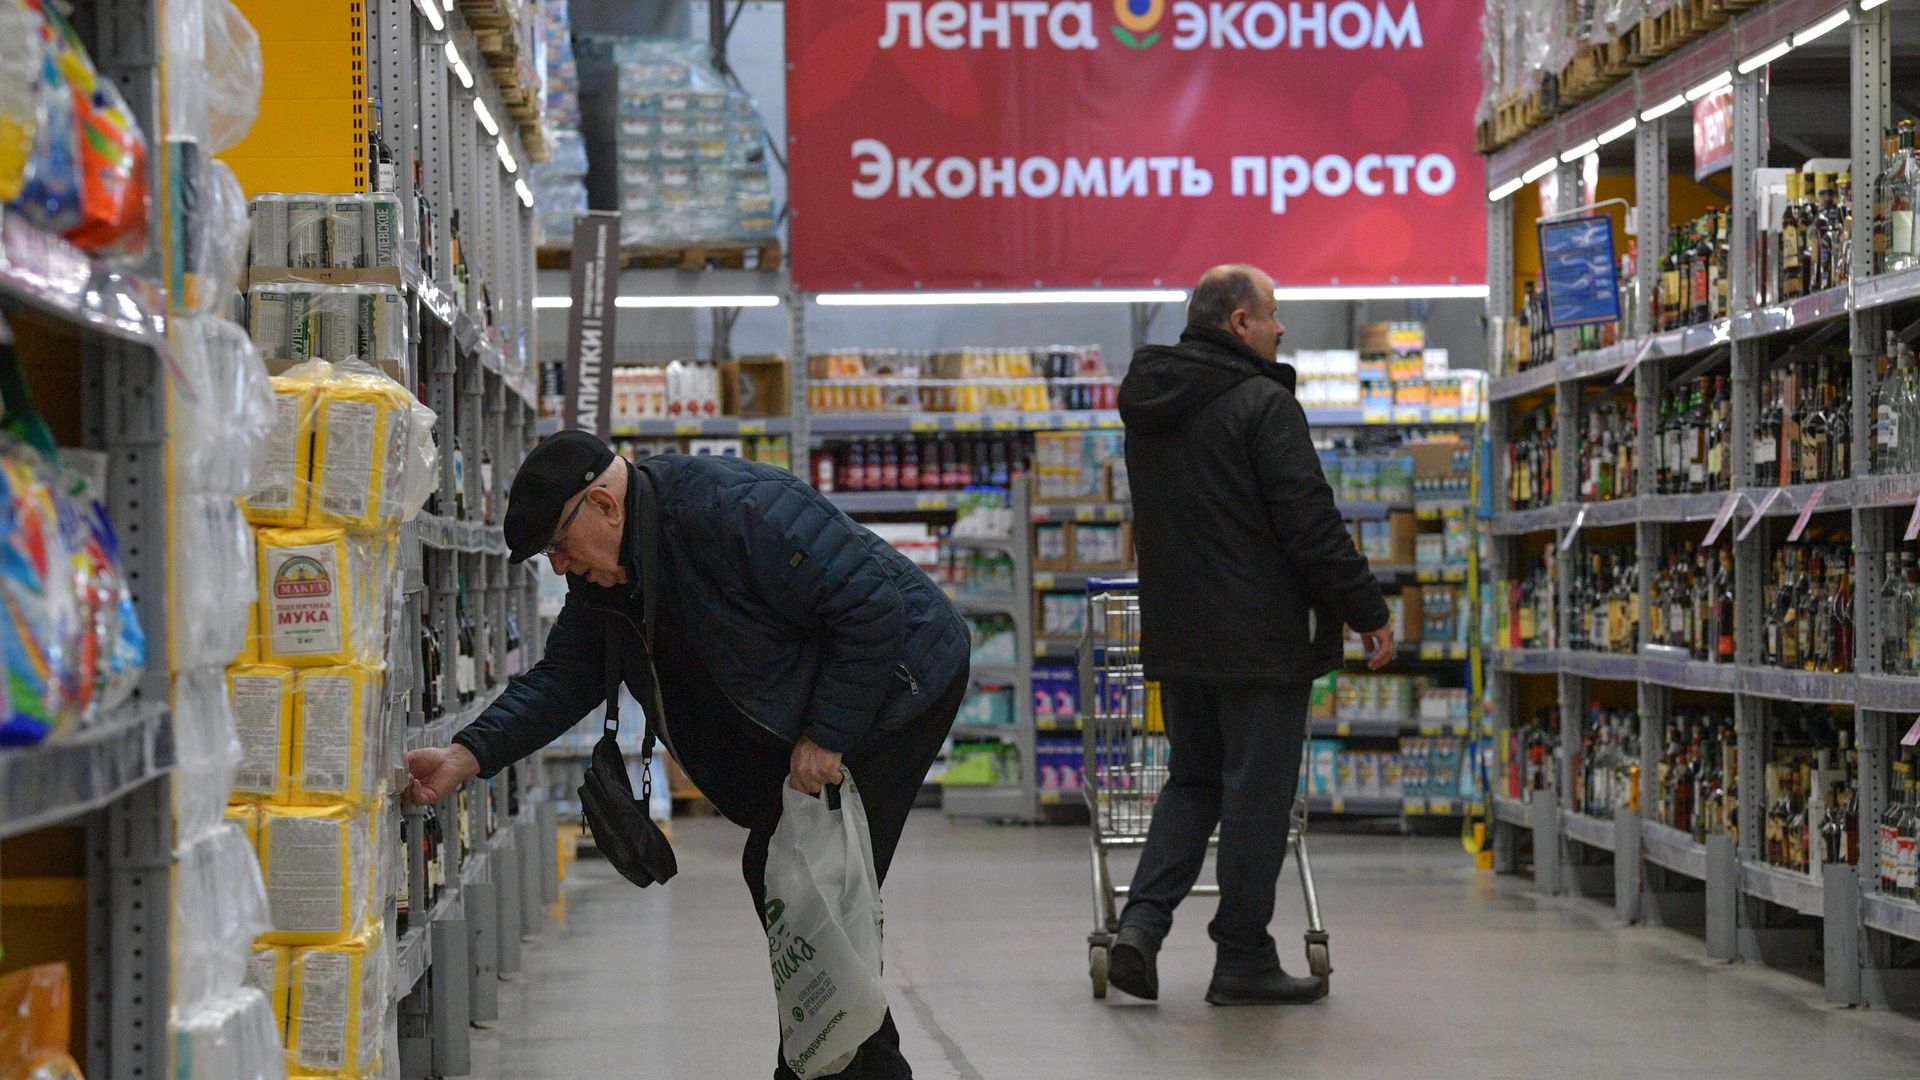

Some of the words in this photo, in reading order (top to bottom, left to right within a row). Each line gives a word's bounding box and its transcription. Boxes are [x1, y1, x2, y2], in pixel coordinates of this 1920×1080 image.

[852, 139, 1213, 198] Экономить
[1231, 153, 1456, 214] просто
[277, 610, 330, 625] МУКА
